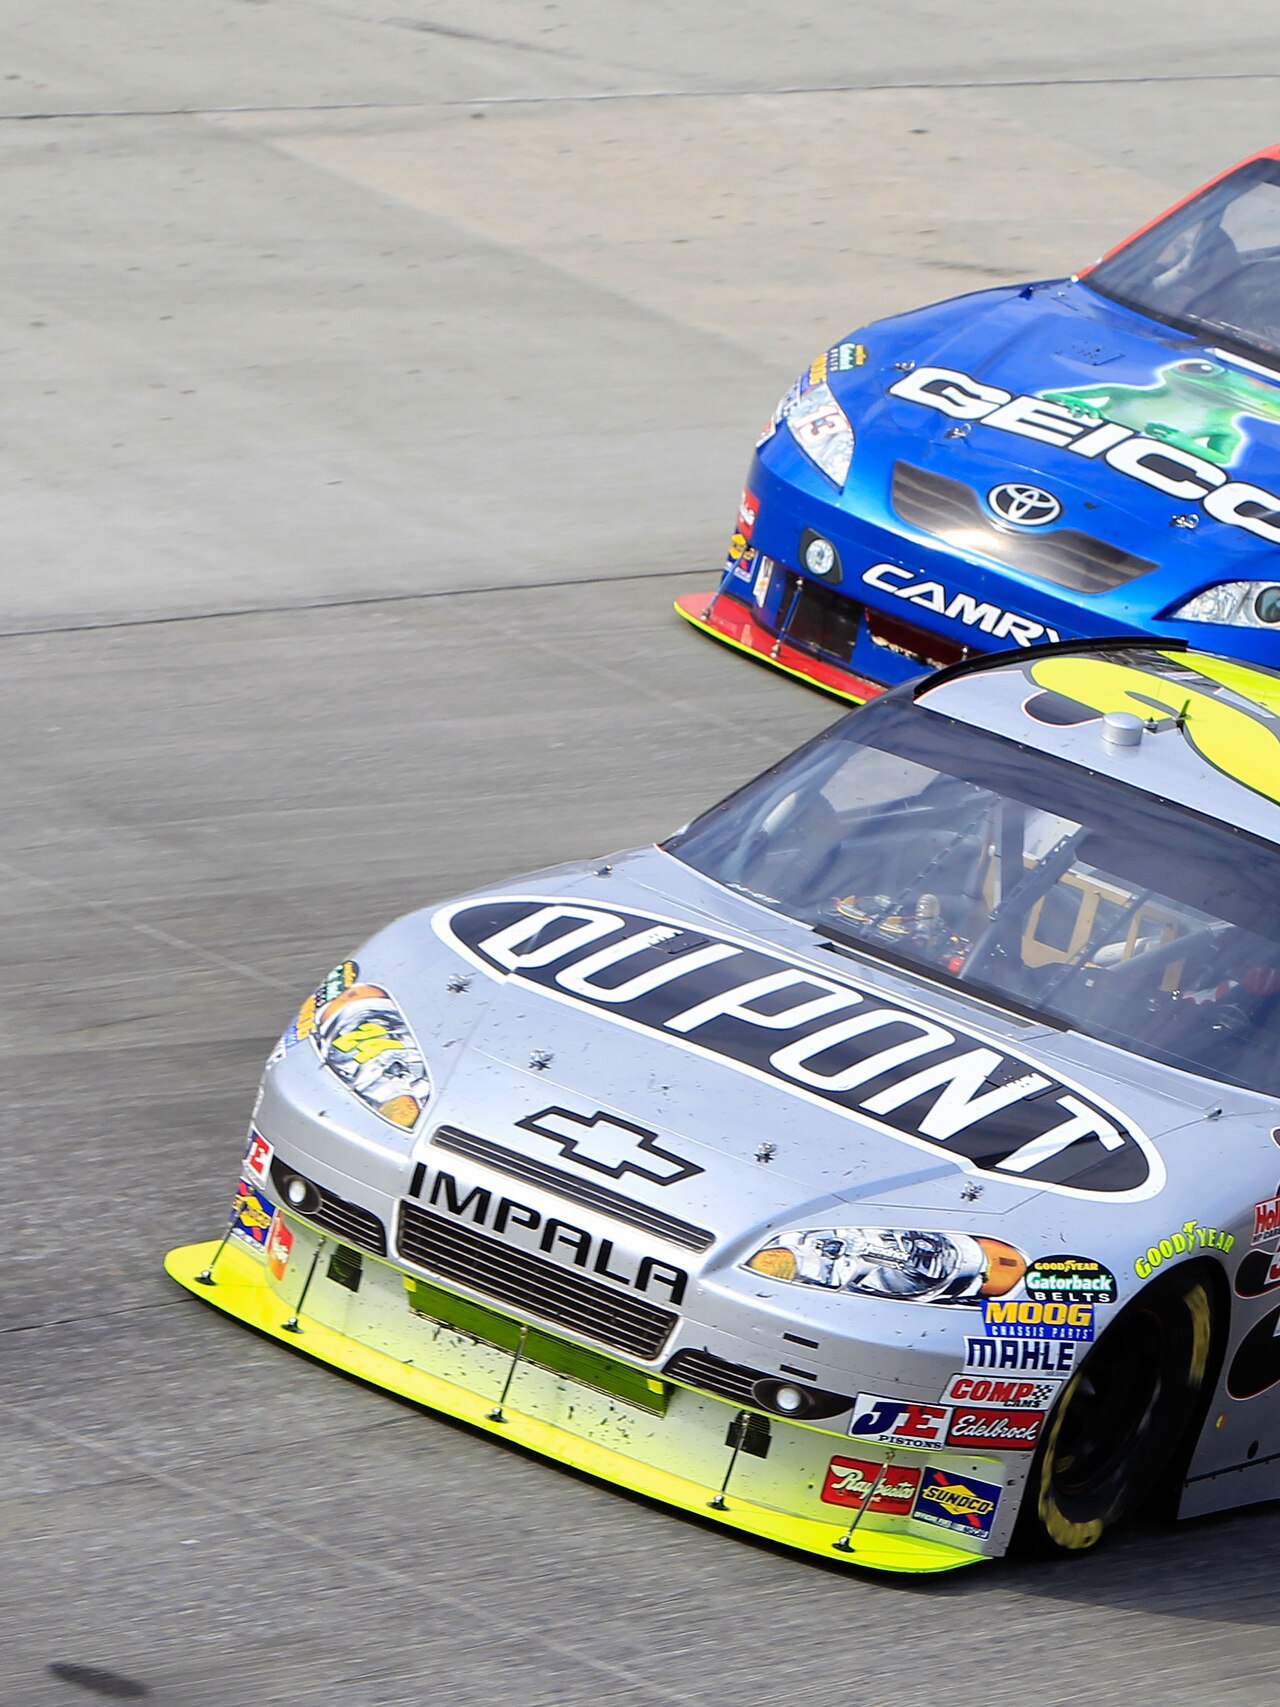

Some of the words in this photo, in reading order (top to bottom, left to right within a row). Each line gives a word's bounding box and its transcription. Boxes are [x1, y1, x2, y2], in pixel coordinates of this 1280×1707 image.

[331, 1022, 406, 1064] 24
[408, 1162, 689, 1306] IMPALA
[1134, 1220, 1236, 1280] GOODYEAR
[1034, 1259, 1099, 1273] GOODYEAR
[1026, 1271, 1113, 1292] Gatorback
[1034, 1291, 1111, 1303] BELTS
[985, 1302, 1093, 1327] MOOG
[991, 1325, 1044, 1337] CHASSIS
[1052, 1326, 1089, 1340] PARTS
[967, 1337, 1075, 1371] MAHLE
[950, 1378, 1035, 1403] COMP
[1003, 1400, 1042, 1409] CAMS
[851, 1401, 947, 1439] JE
[950, 1414, 1040, 1441] Edelbrock
[878, 1434, 943, 1450] PISTONS
[925, 1487, 991, 1513] SUNOCO
